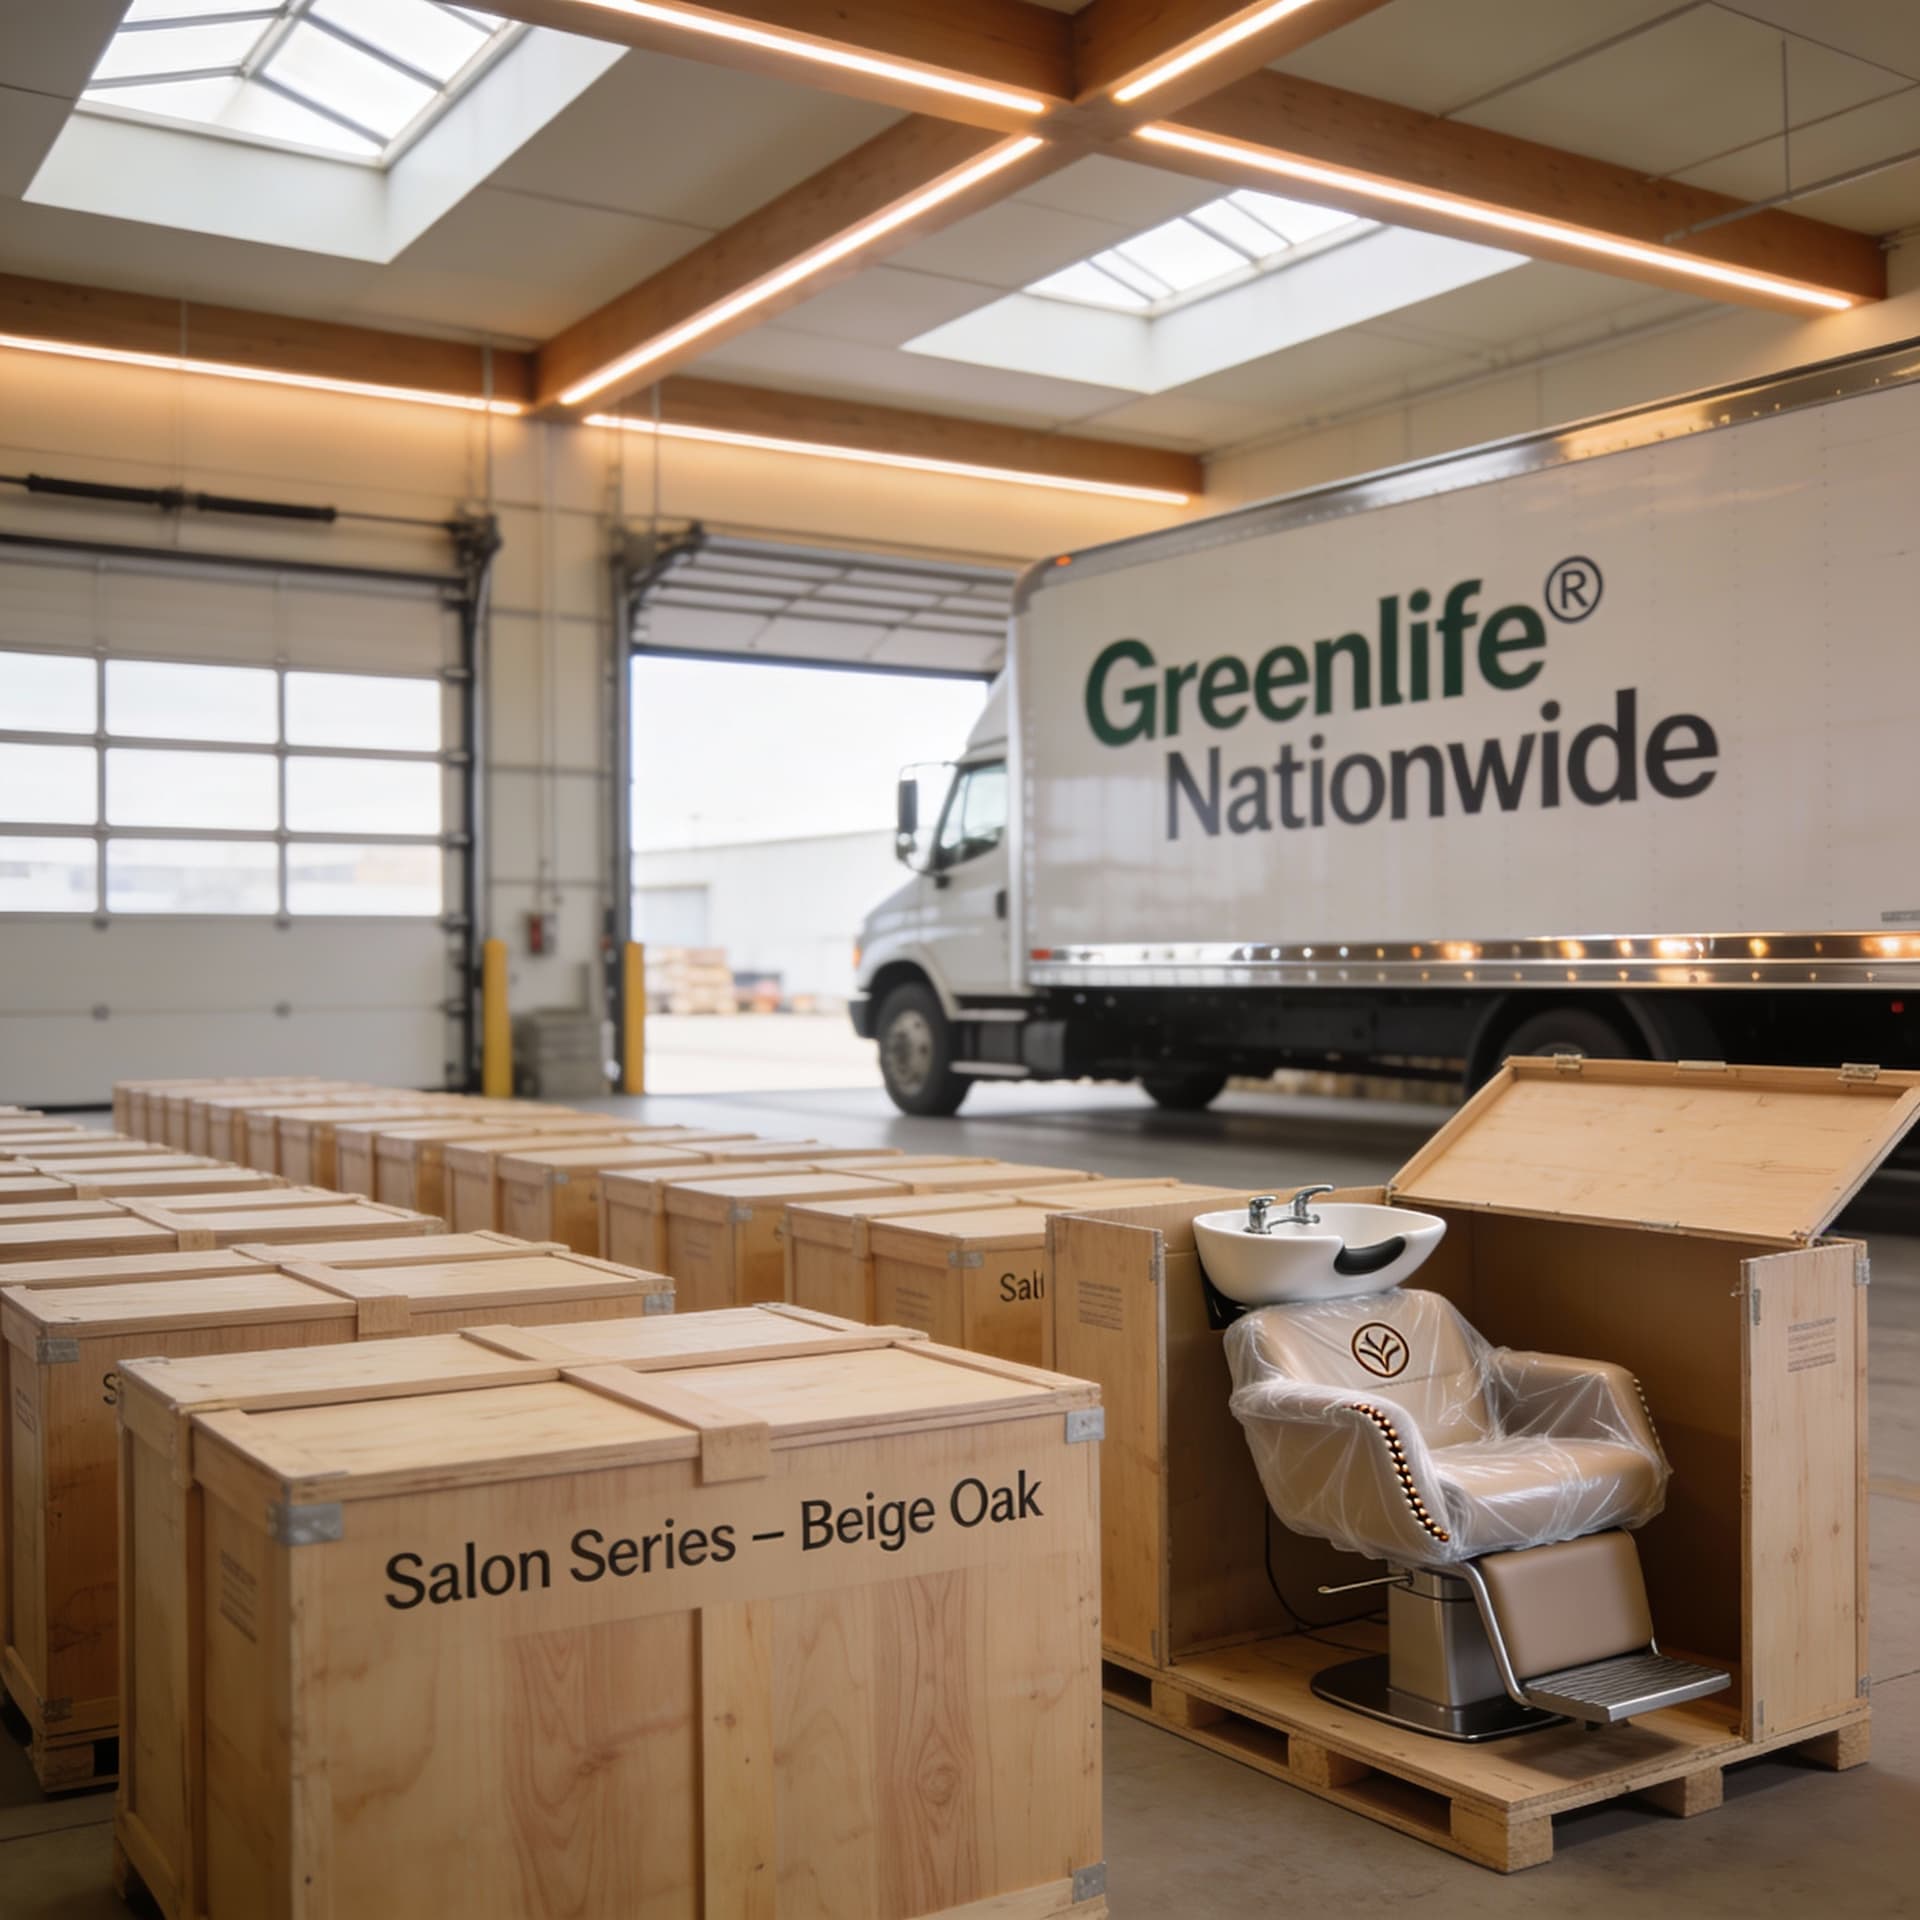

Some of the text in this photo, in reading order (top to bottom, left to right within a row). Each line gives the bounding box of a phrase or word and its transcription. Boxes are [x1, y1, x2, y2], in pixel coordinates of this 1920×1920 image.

[1166, 687, 1720, 840] Nationwide
[384, 1541, 552, 1611] Salon
[569, 1518, 737, 1583] Series
[801, 1492, 936, 1552] Beige
[949, 1469, 1044, 1528] Oak
